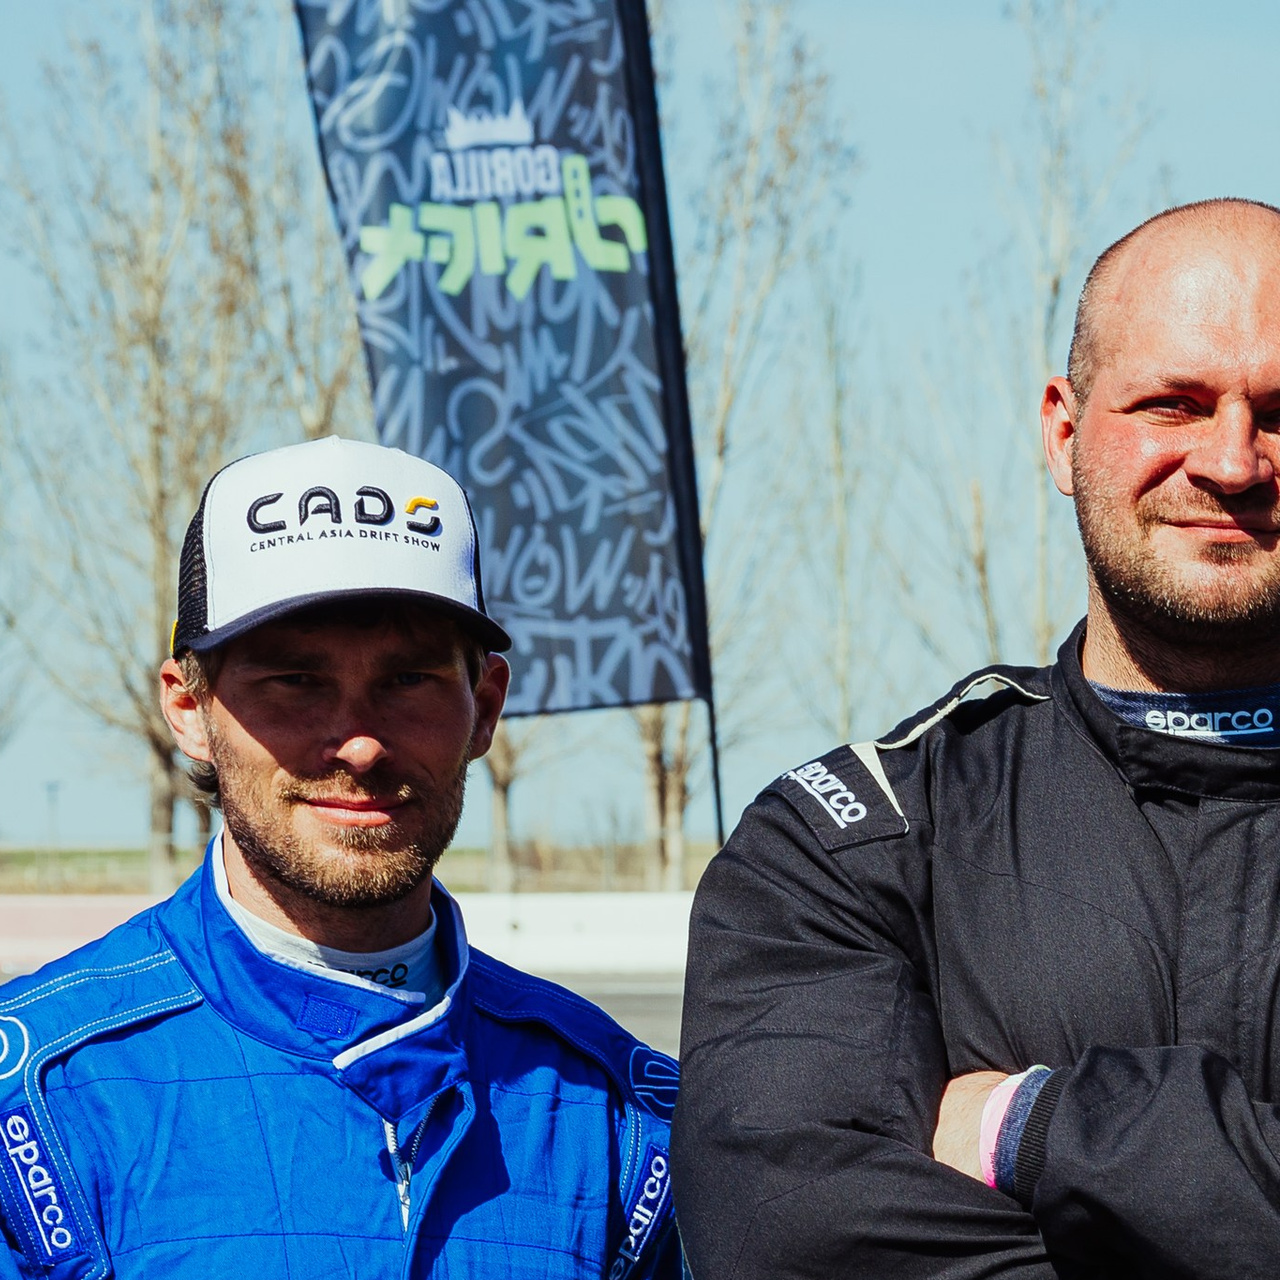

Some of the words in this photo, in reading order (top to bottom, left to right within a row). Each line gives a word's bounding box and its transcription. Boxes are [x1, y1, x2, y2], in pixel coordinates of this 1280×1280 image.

[247, 485, 443, 537] CADS
[250, 530, 314, 553] CENTRAL
[318, 529, 354, 540] ASIA
[359, 529, 400, 543] DRIFT
[403, 535, 441, 552] SHOW
[1145, 708, 1274, 736] sparco
[785, 761, 868, 829] sparco
[4, 1114, 72, 1256] sparco
